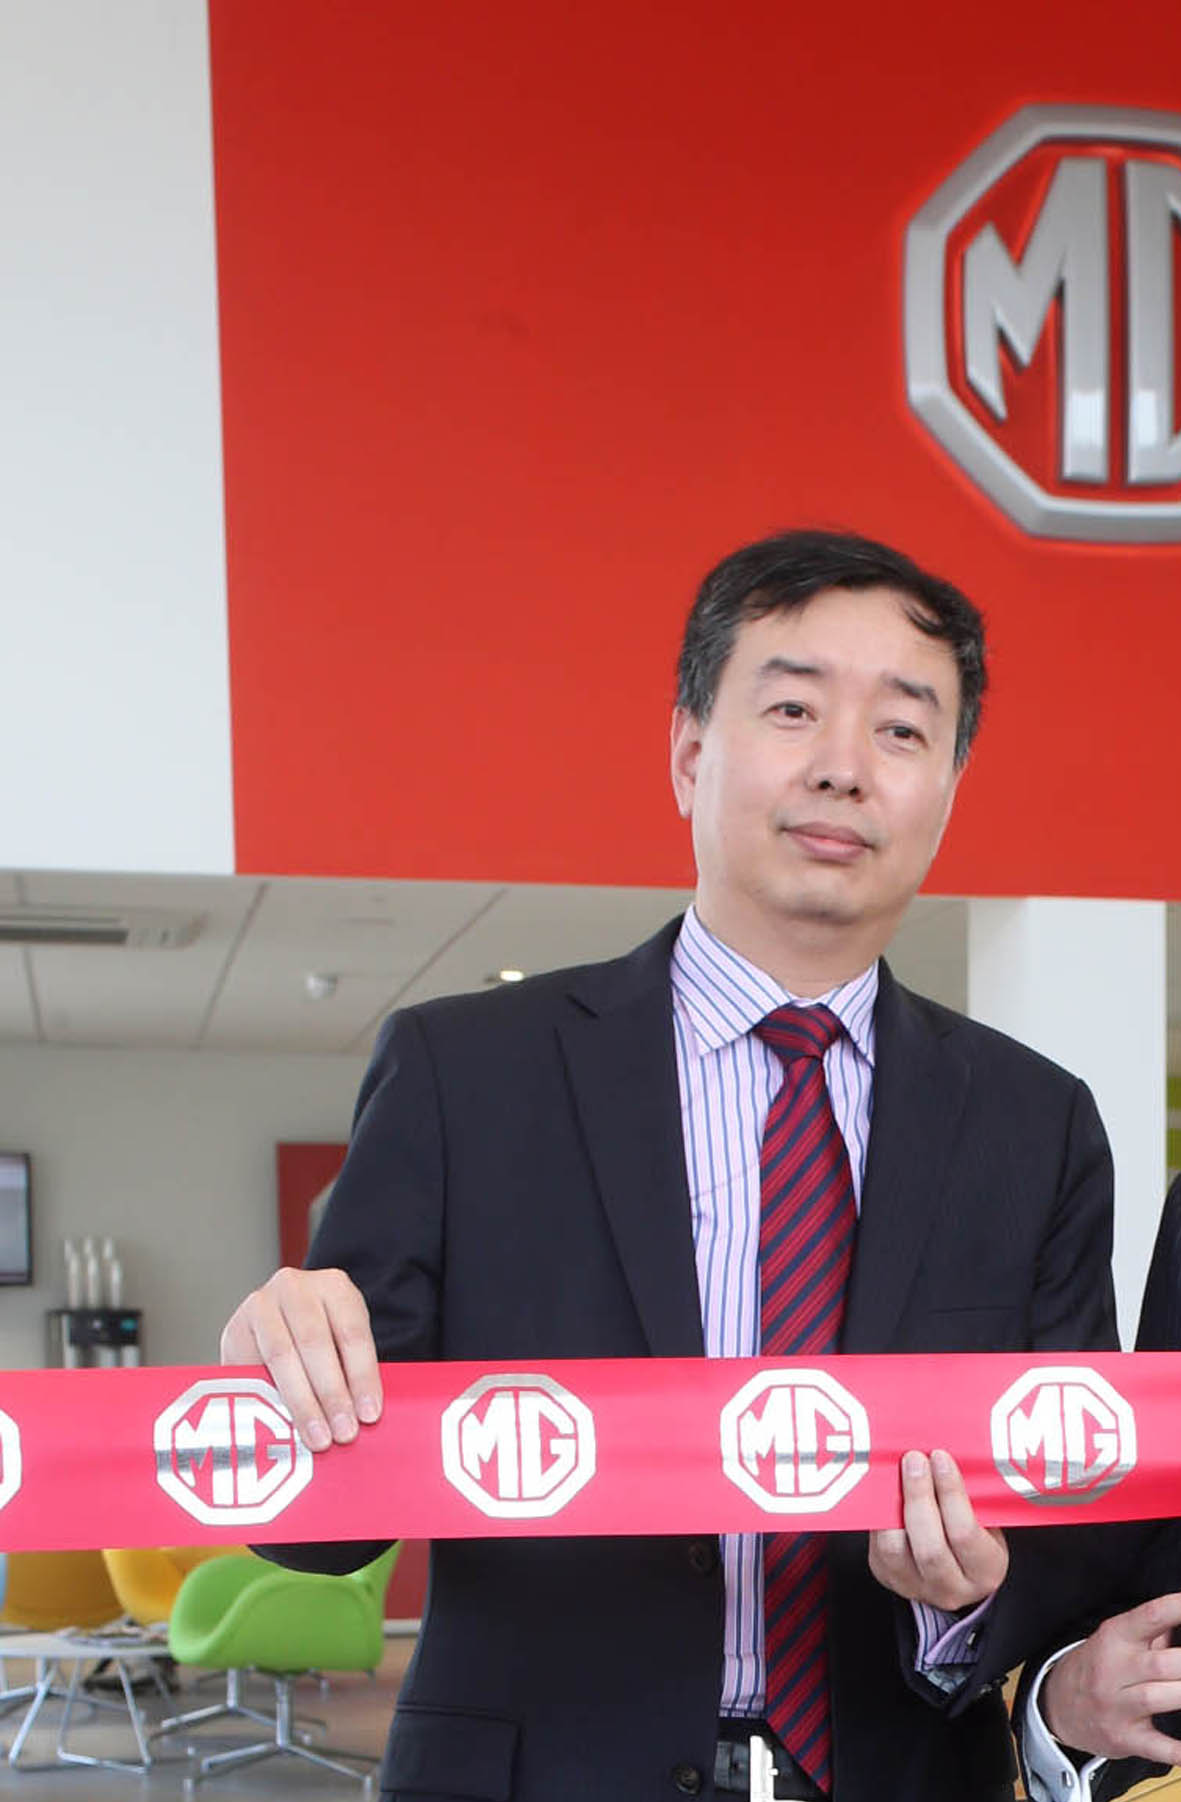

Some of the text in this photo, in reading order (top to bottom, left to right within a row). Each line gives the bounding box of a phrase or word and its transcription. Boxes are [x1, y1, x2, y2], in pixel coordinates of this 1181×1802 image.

[173, 1396, 294, 1506] MG
[463, 1390, 577, 1500] MG
[739, 1386, 853, 1495] MG
[1007, 1384, 1118, 1492] MG
